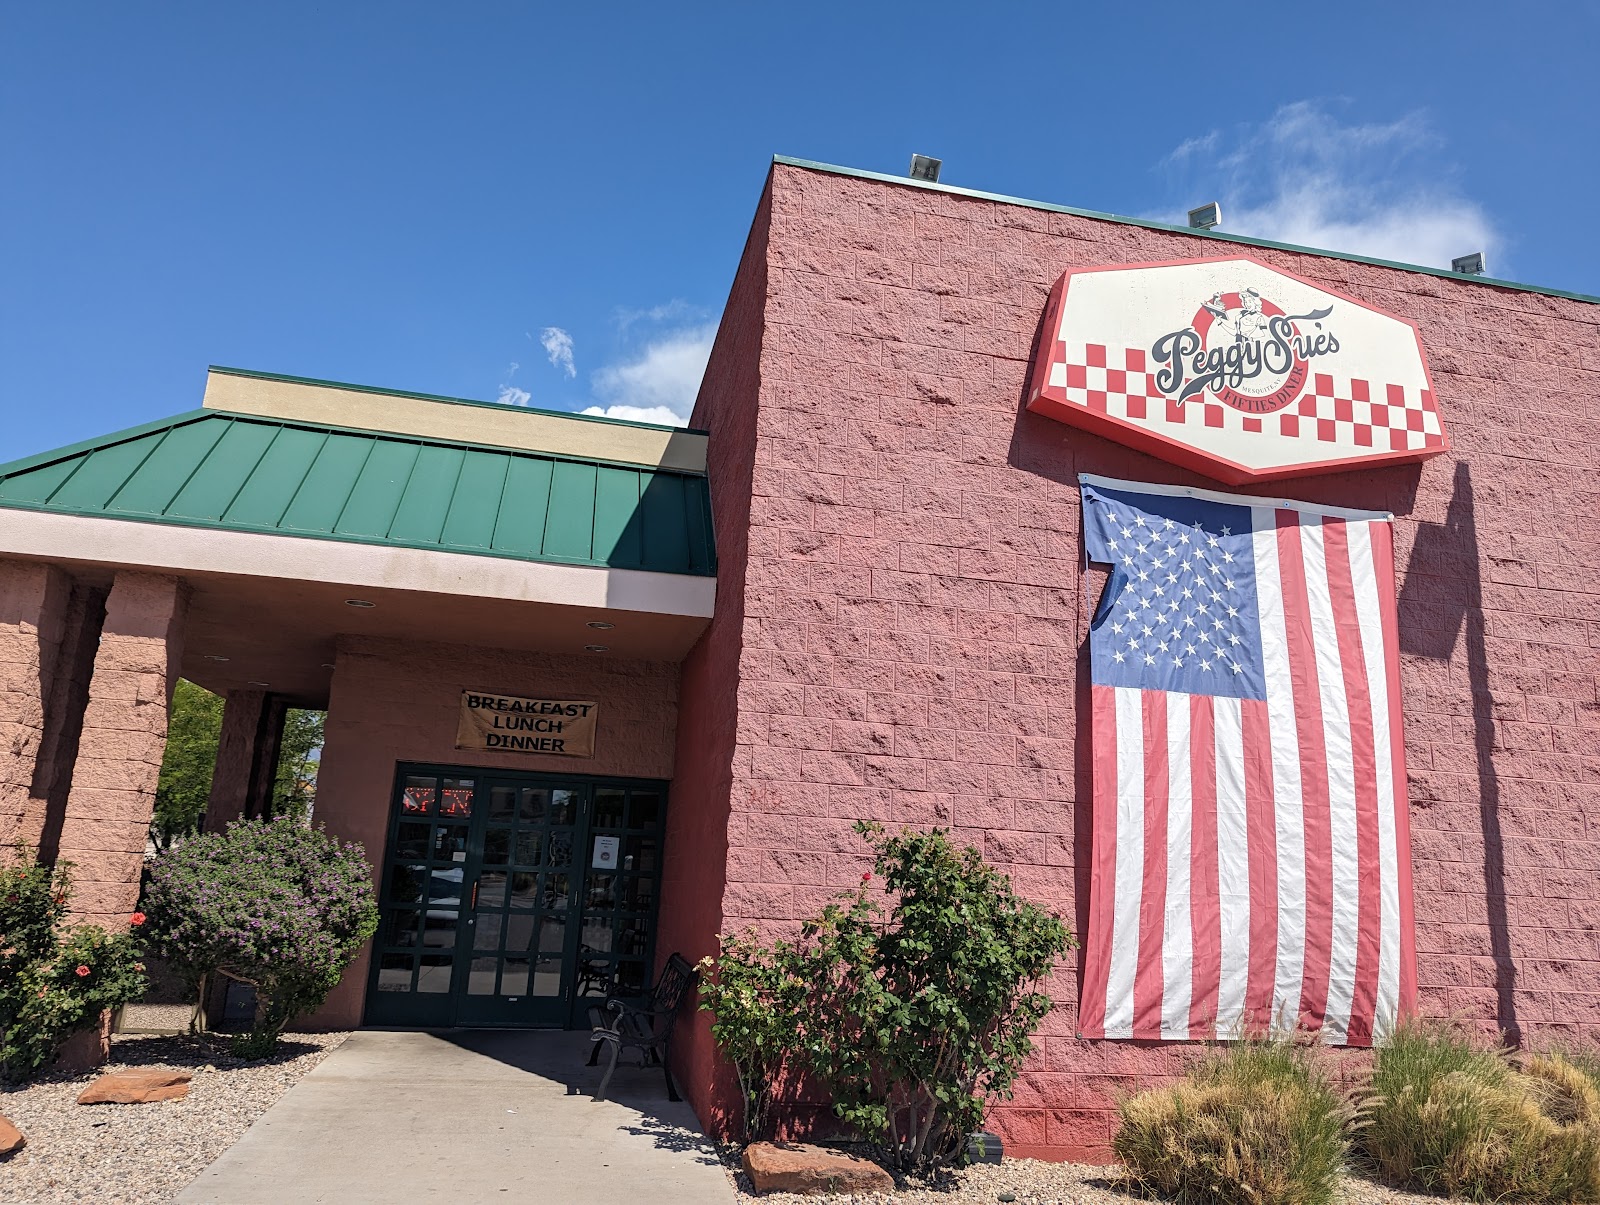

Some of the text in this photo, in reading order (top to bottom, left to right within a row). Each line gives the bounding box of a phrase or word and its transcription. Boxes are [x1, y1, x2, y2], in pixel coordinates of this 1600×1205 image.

[1151, 304, 1340, 406] Peggy Sue's
[1223, 366, 1304, 412] FIFTIES DINER
[467, 695, 592, 717] BREAKFAST
[493, 716, 562, 733] LUNCH
[486, 733, 565, 752] DINNER
